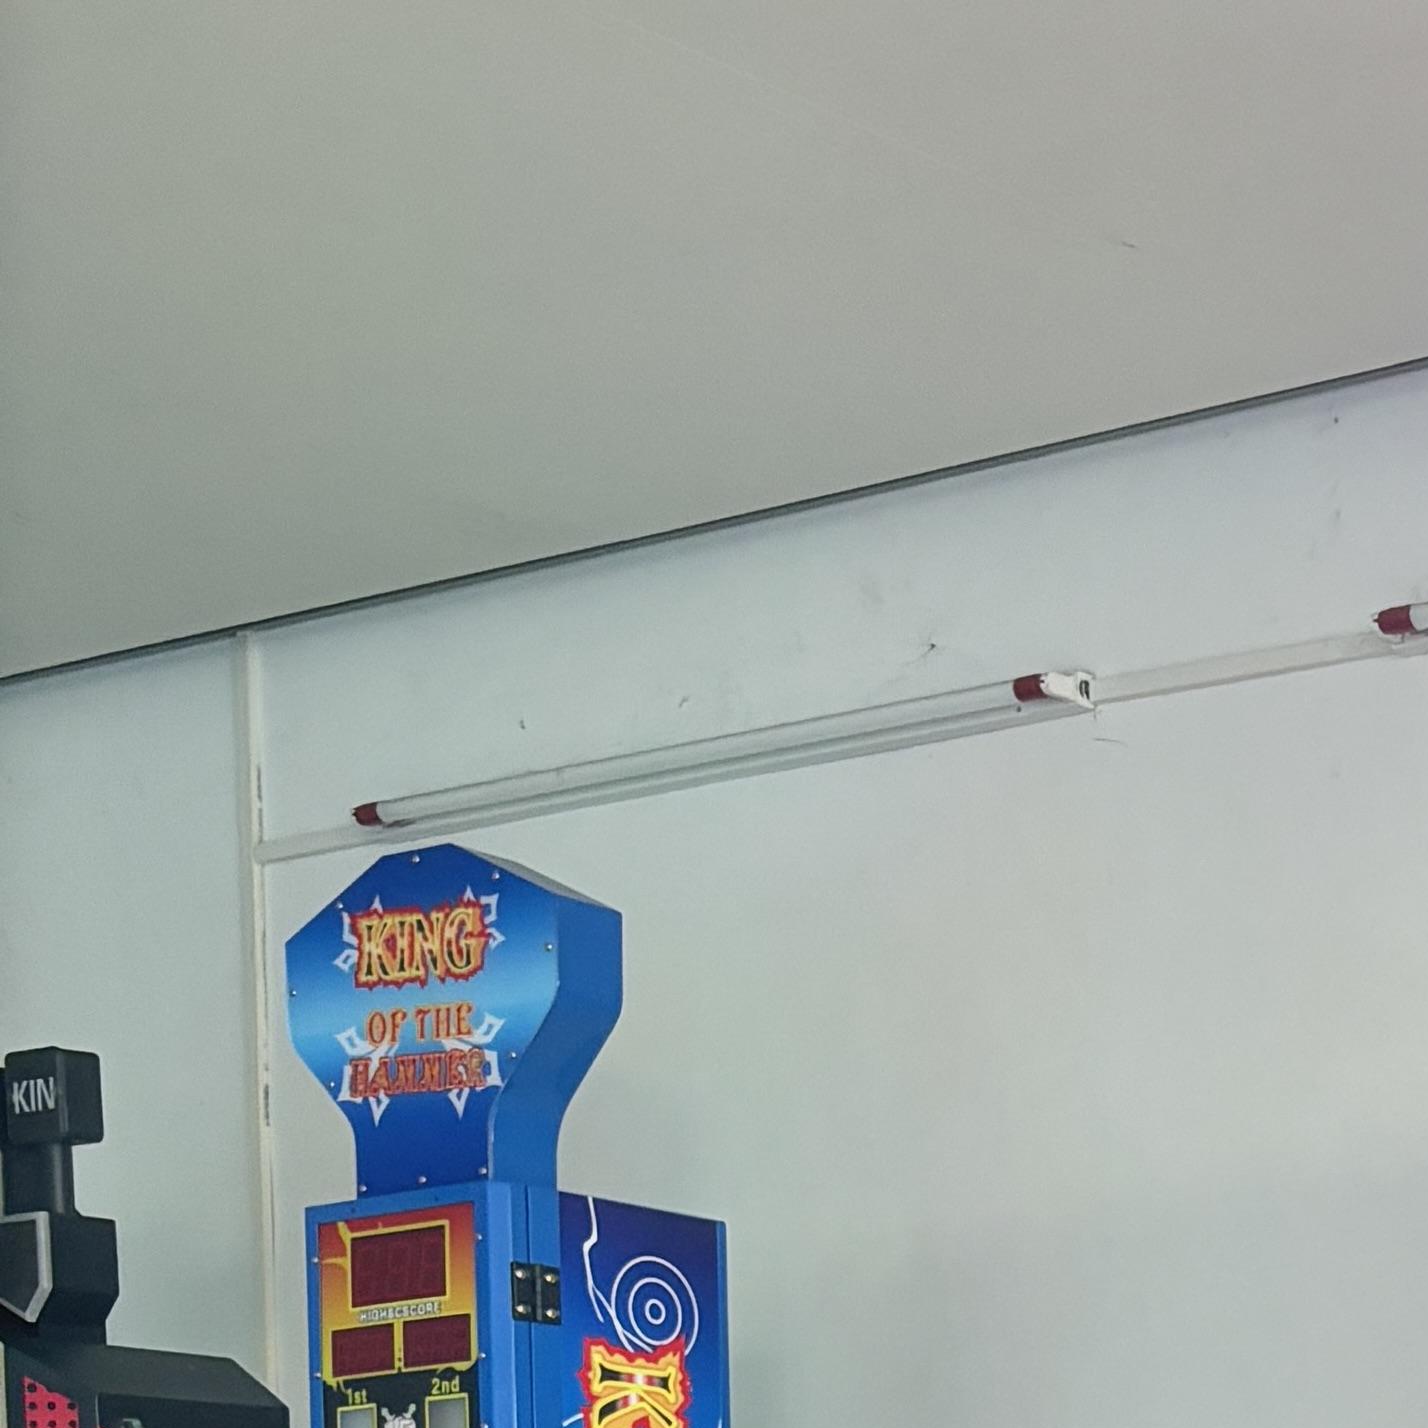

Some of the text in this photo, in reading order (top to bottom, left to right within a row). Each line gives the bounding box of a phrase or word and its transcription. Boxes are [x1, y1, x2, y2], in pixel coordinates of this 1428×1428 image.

[354, 903, 486, 987] KING
[366, 1002, 474, 1047] OF THE
[350, 1048, 486, 1098] HAMMER
[12, 1076, 56, 1114] KIN
[348, 1388, 368, 1405] 1st
[430, 1377, 461, 1395] 2nd
